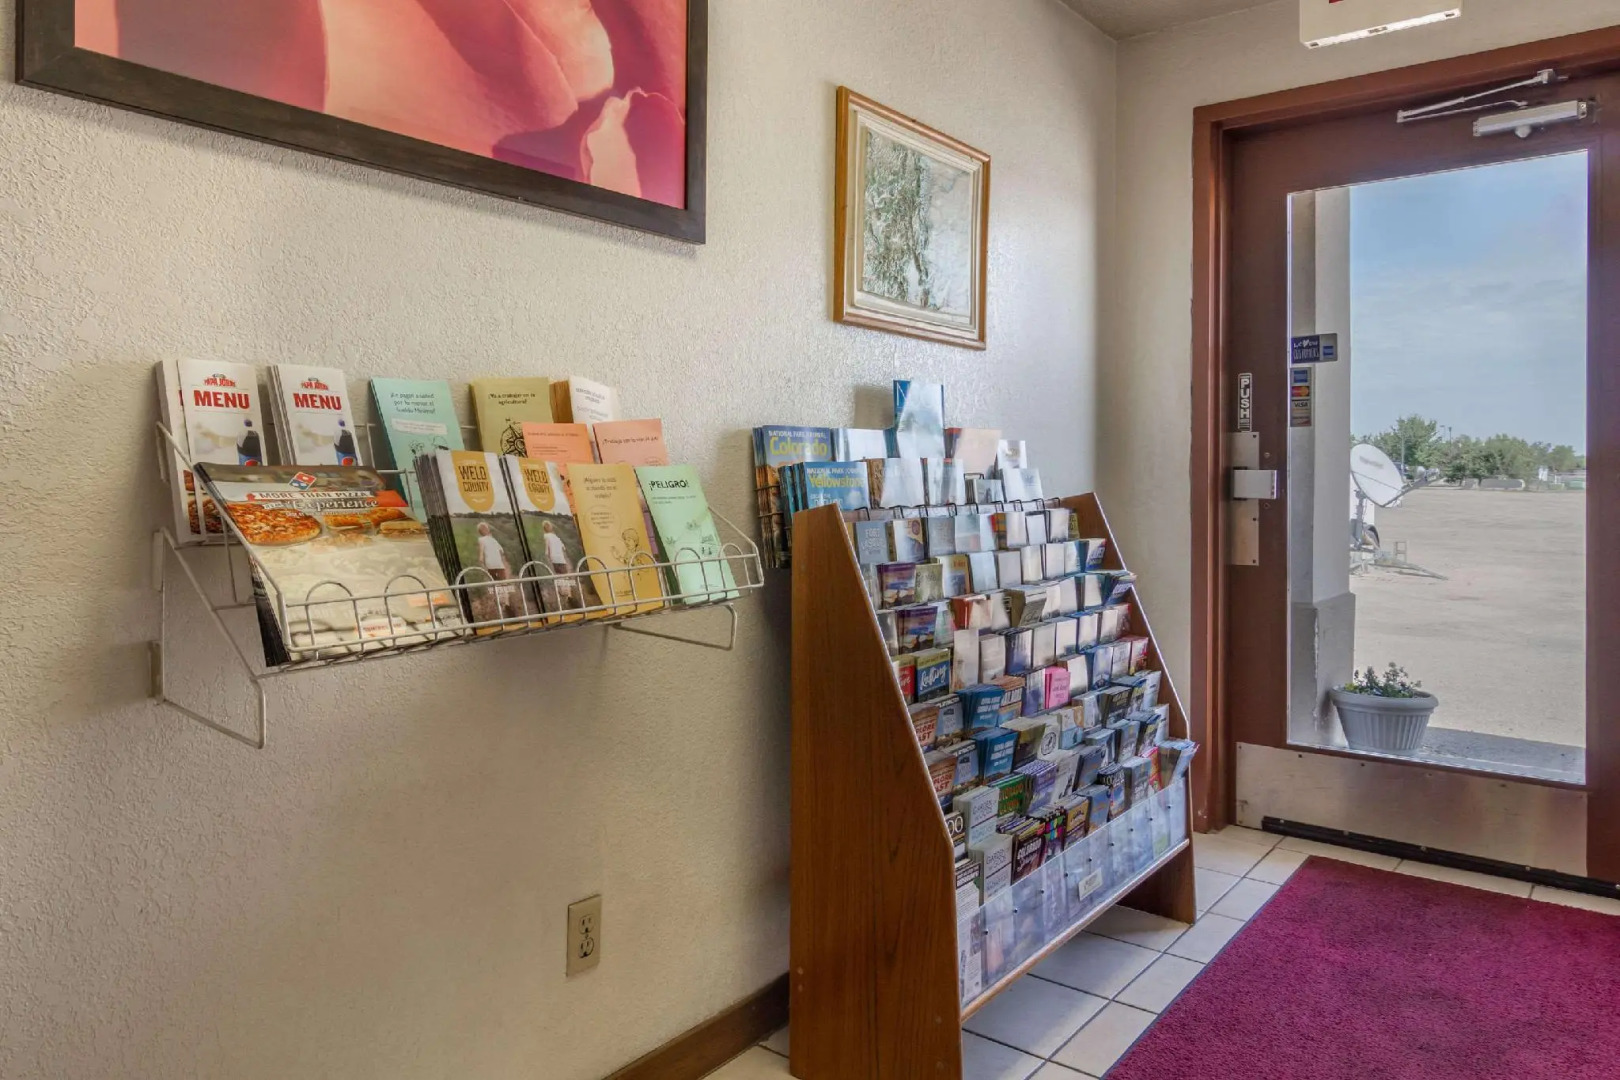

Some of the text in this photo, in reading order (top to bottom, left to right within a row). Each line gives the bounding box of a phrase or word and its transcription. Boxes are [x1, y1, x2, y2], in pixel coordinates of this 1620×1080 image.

[193, 389, 250, 409] MENU
[293, 393, 342, 411] MENU
[1240, 378, 1250, 419] PUSH
[769, 437, 829, 456] Colorado
[458, 465, 487, 480] WELD
[524, 469, 549, 483] WELD
[462, 481, 489, 492] COUNTY
[649, 479, 690, 491] ¡PELIGRO!
[809, 474, 865, 488] Yellowstone
[300, 491, 329, 499] THAN
[335, 490, 369, 498] PIZZA
